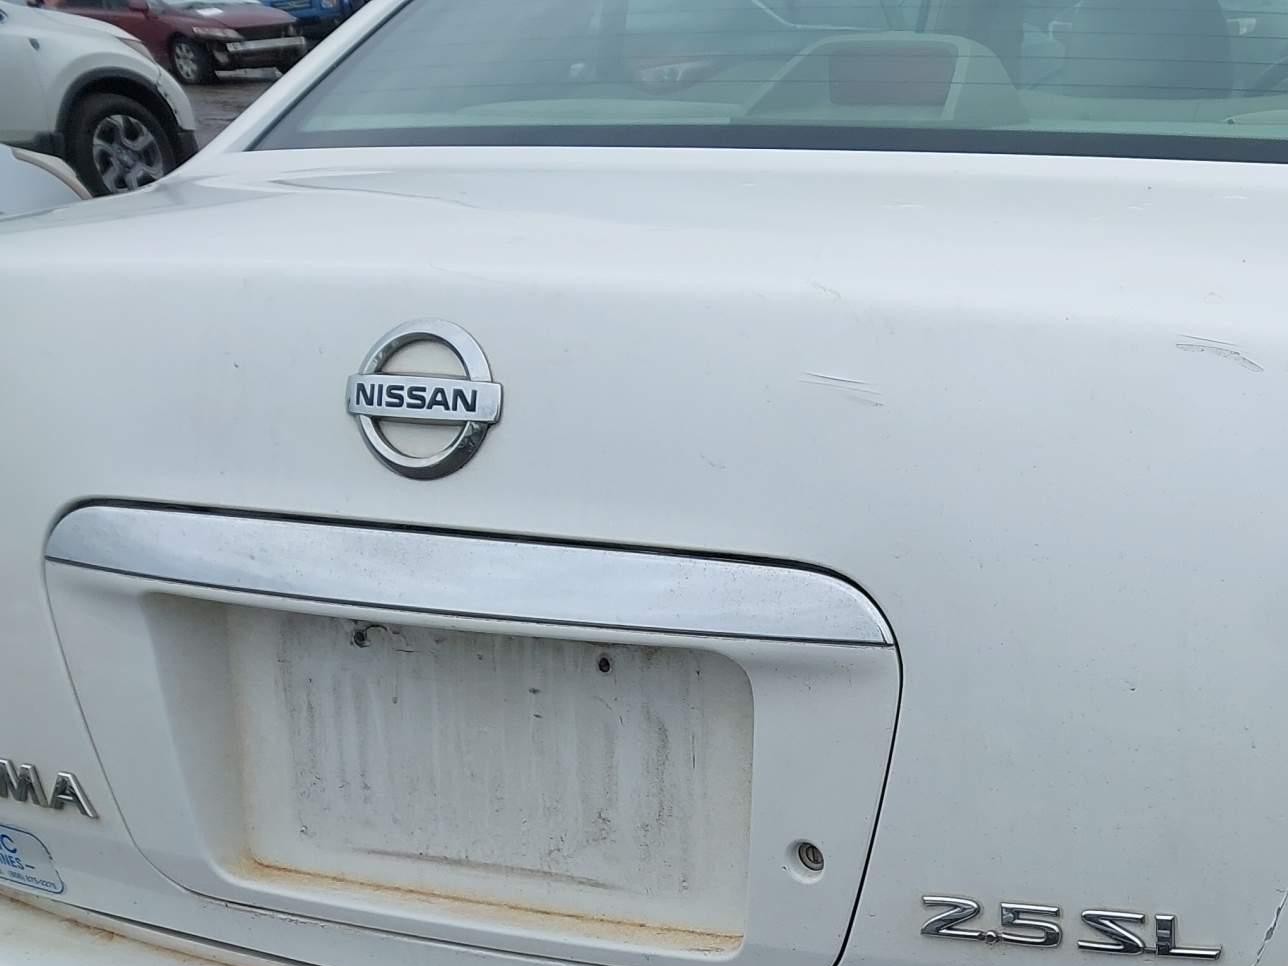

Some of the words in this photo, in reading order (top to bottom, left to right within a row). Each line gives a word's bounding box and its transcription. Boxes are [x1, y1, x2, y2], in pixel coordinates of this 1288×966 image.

[355, 382, 478, 413] NISSAN
[920, 895, 1062, 948] 2.5
[1077, 909, 1222, 960] SL
